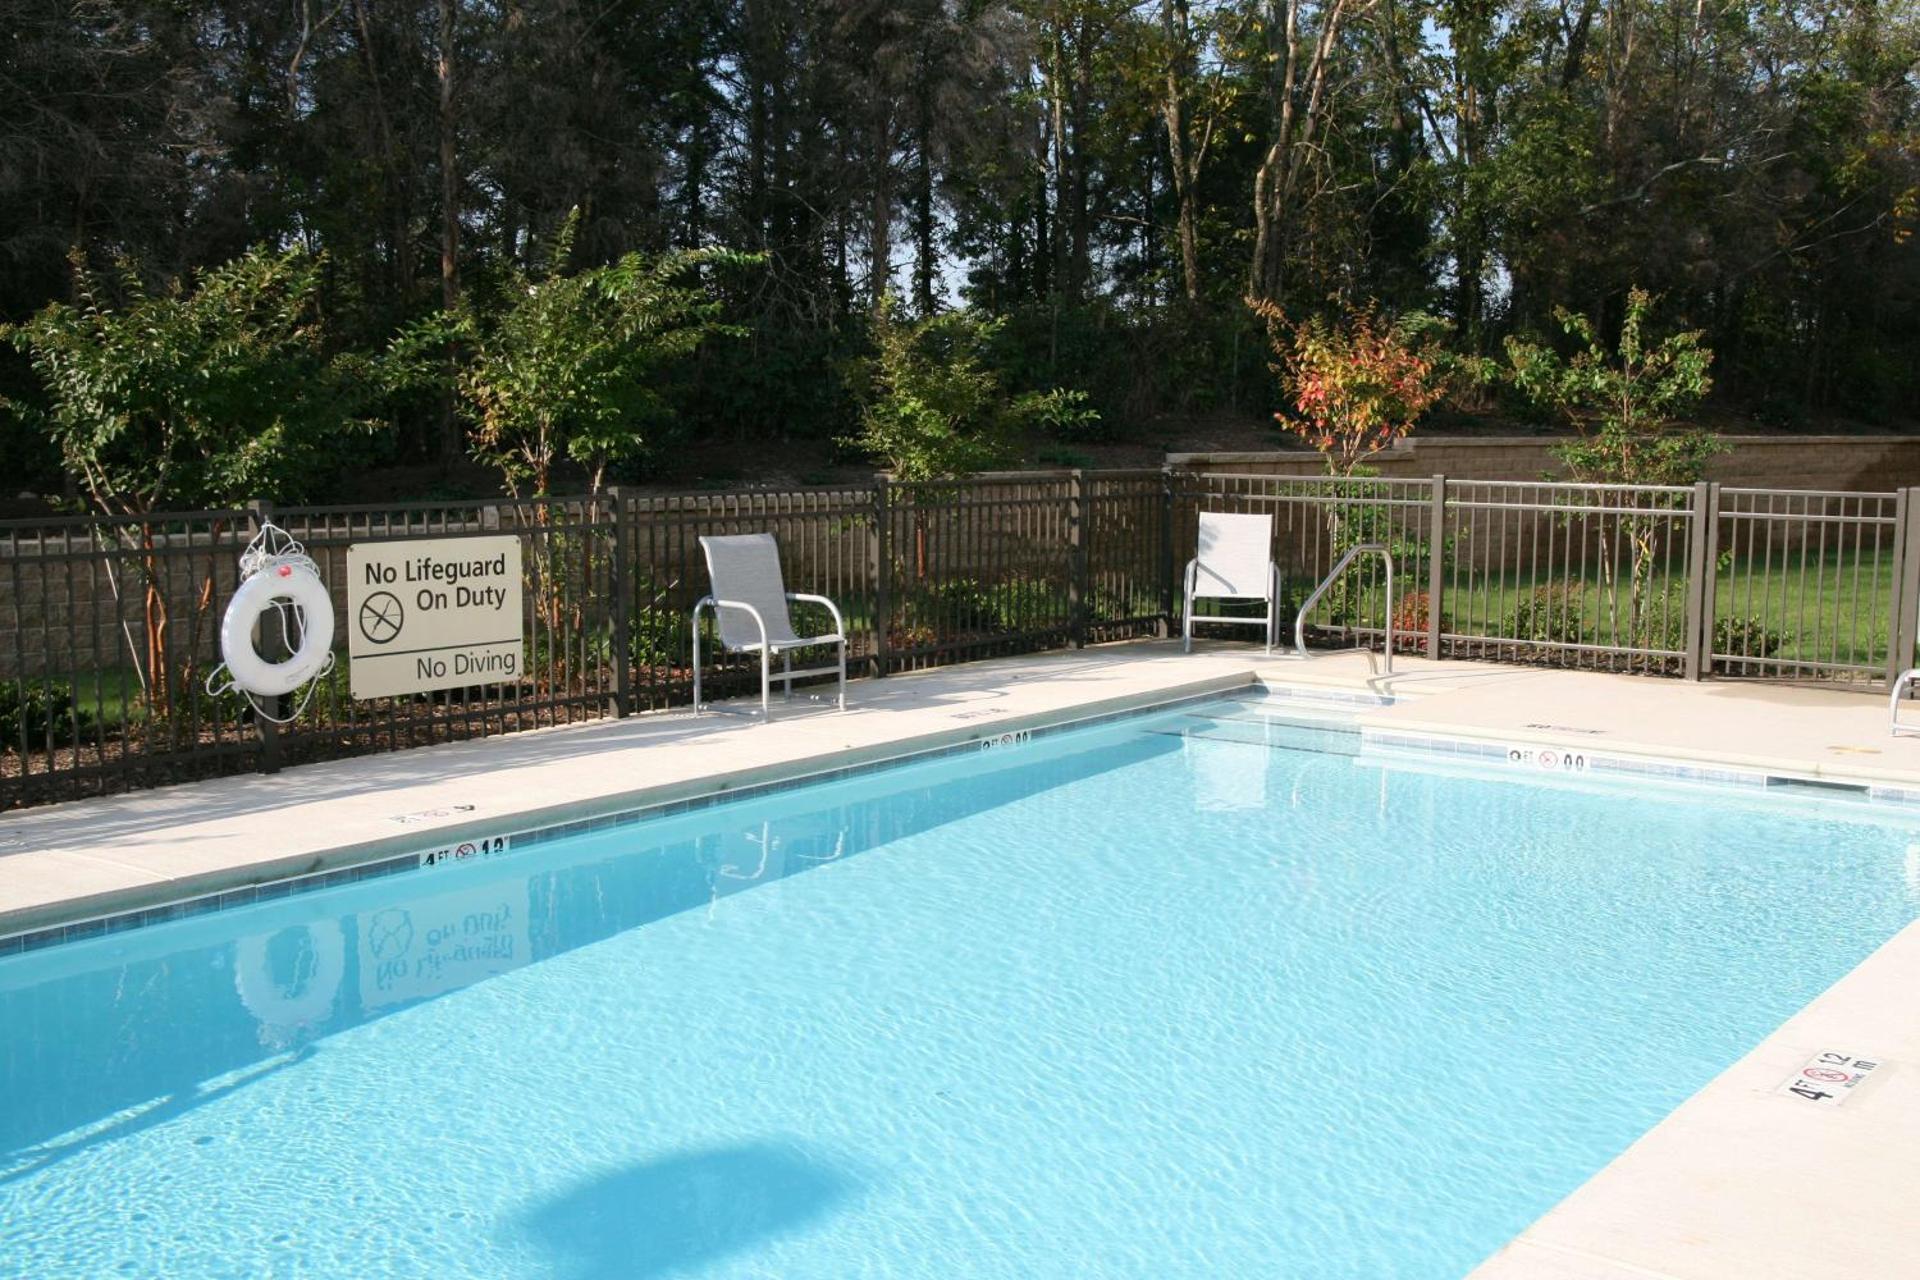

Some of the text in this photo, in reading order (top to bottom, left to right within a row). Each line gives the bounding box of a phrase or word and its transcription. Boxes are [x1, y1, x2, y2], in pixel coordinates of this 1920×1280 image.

[366, 553, 505, 584] No Lifeguard
[417, 586, 506, 611] On Duty
[417, 650, 516, 679] No Diving
[1789, 1086, 1833, 1101] 4
